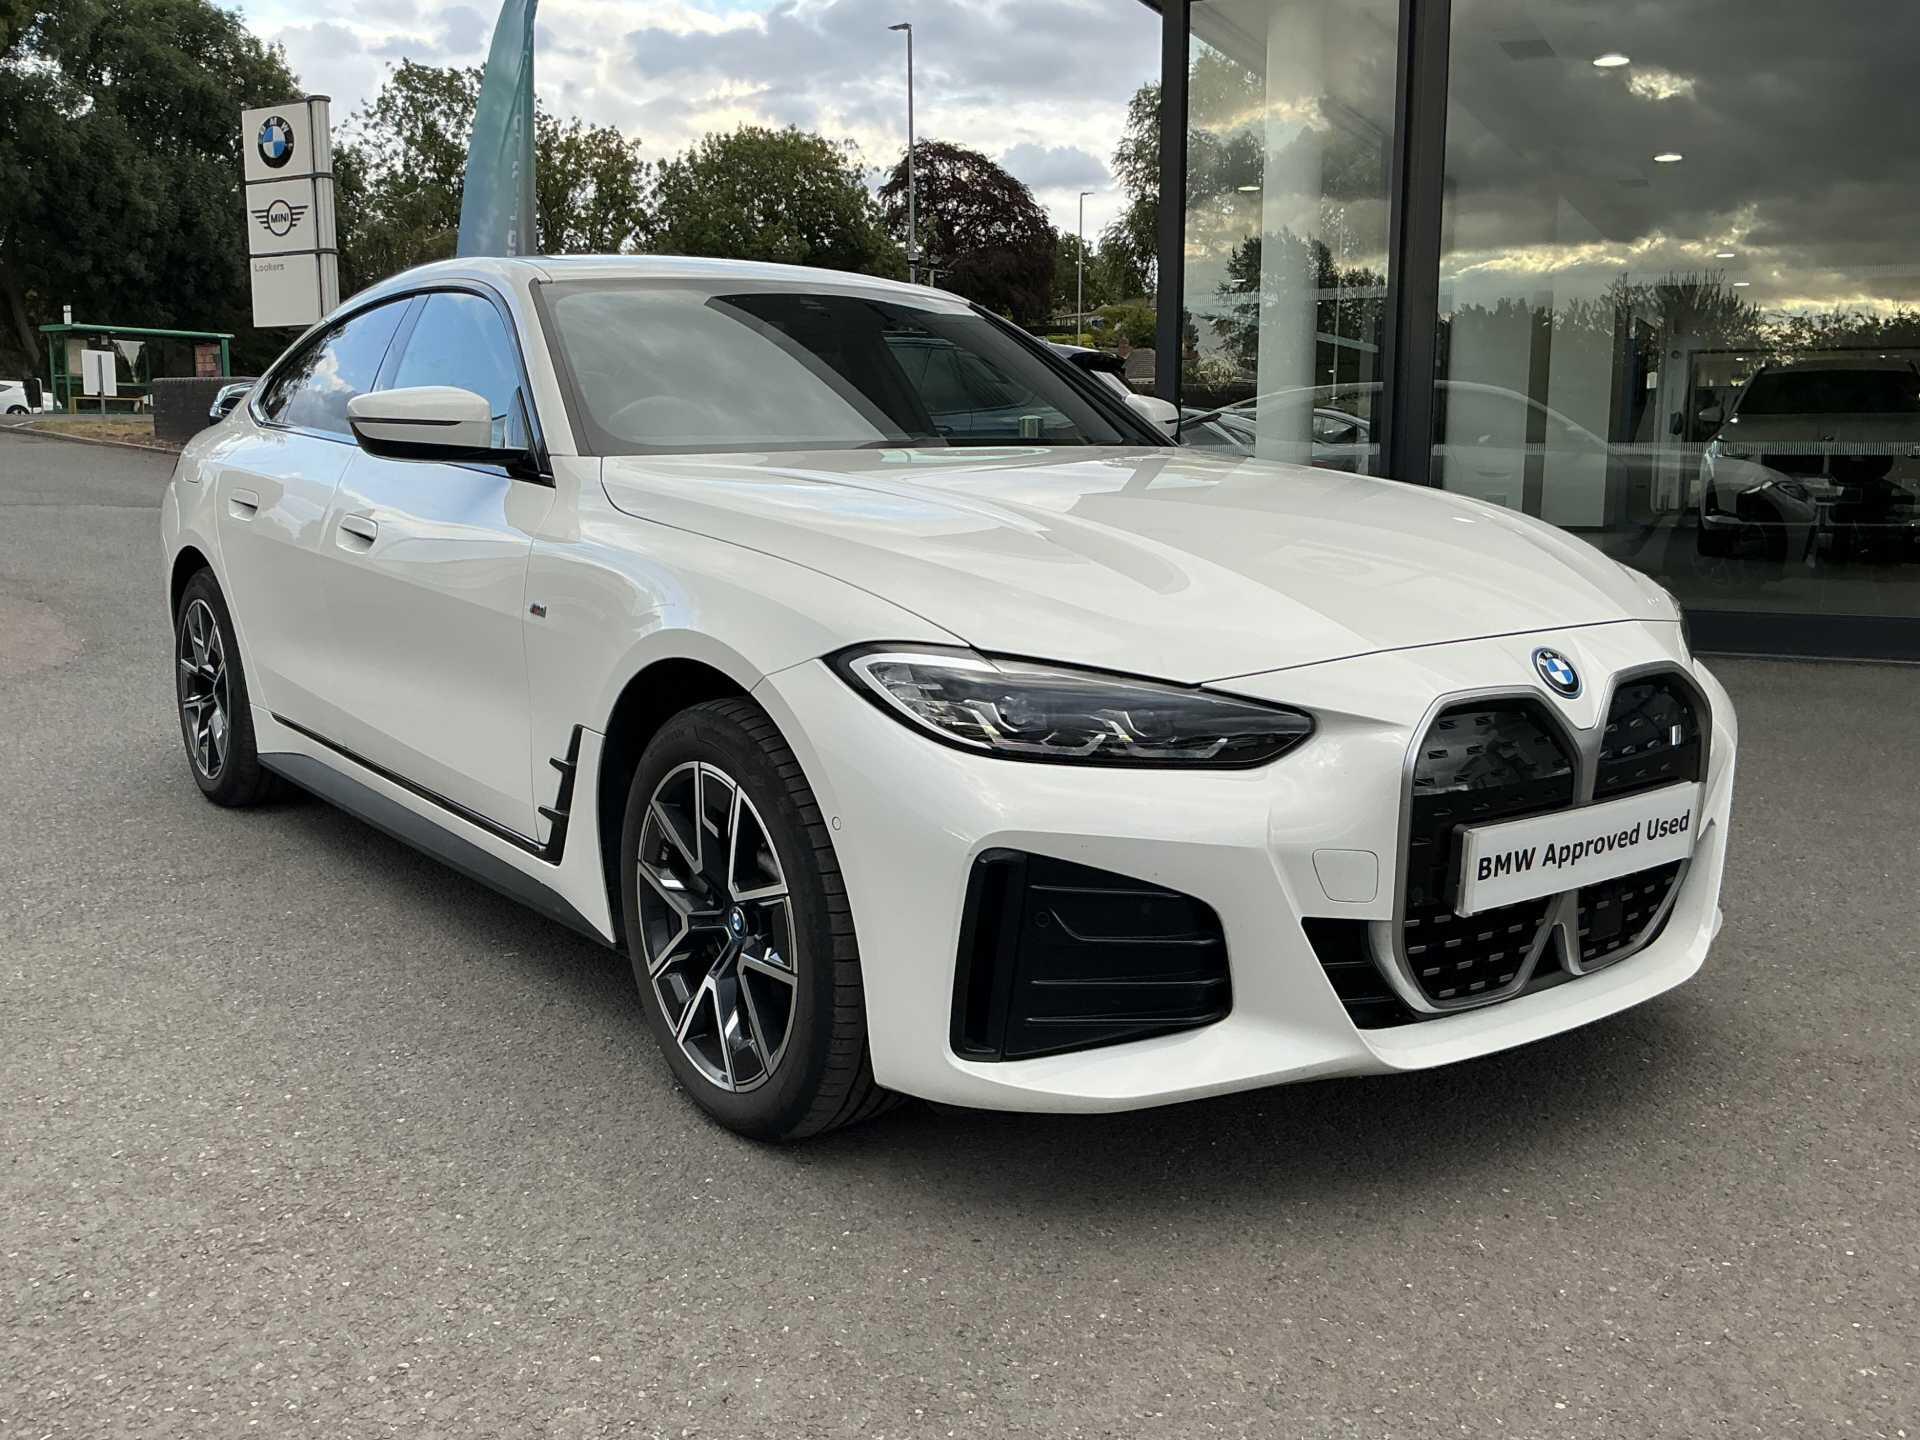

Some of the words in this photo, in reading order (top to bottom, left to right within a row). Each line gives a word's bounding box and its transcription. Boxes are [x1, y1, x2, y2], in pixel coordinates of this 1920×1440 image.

[271, 212, 289, 223] MINI
[254, 263, 285, 272] Lookers
[1477, 847, 1536, 881] BMW
[1542, 822, 1640, 869] Approved
[1646, 809, 1690, 841] Used
